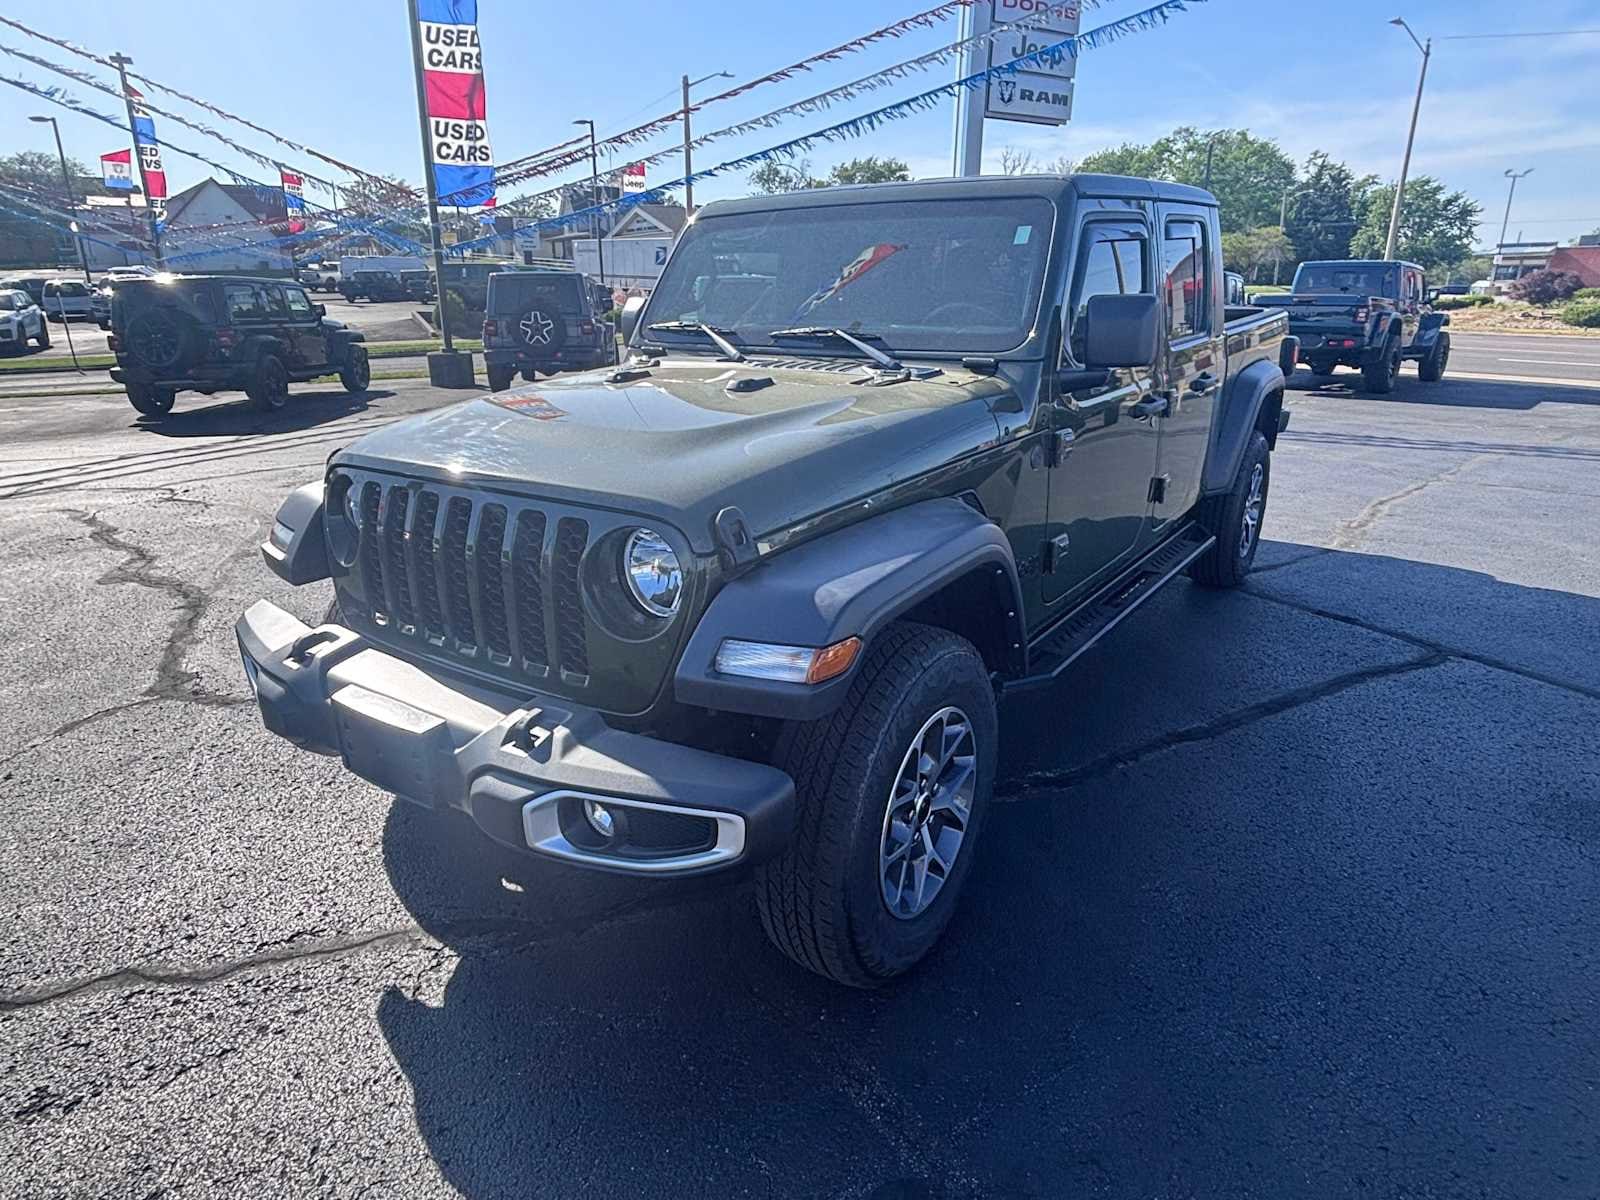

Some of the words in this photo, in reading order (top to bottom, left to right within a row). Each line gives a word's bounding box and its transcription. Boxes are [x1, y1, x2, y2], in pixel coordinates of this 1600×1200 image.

[1019, 88, 1069, 106] RAM
[434, 120, 485, 142] USED
[436, 142, 490, 162] CARS
